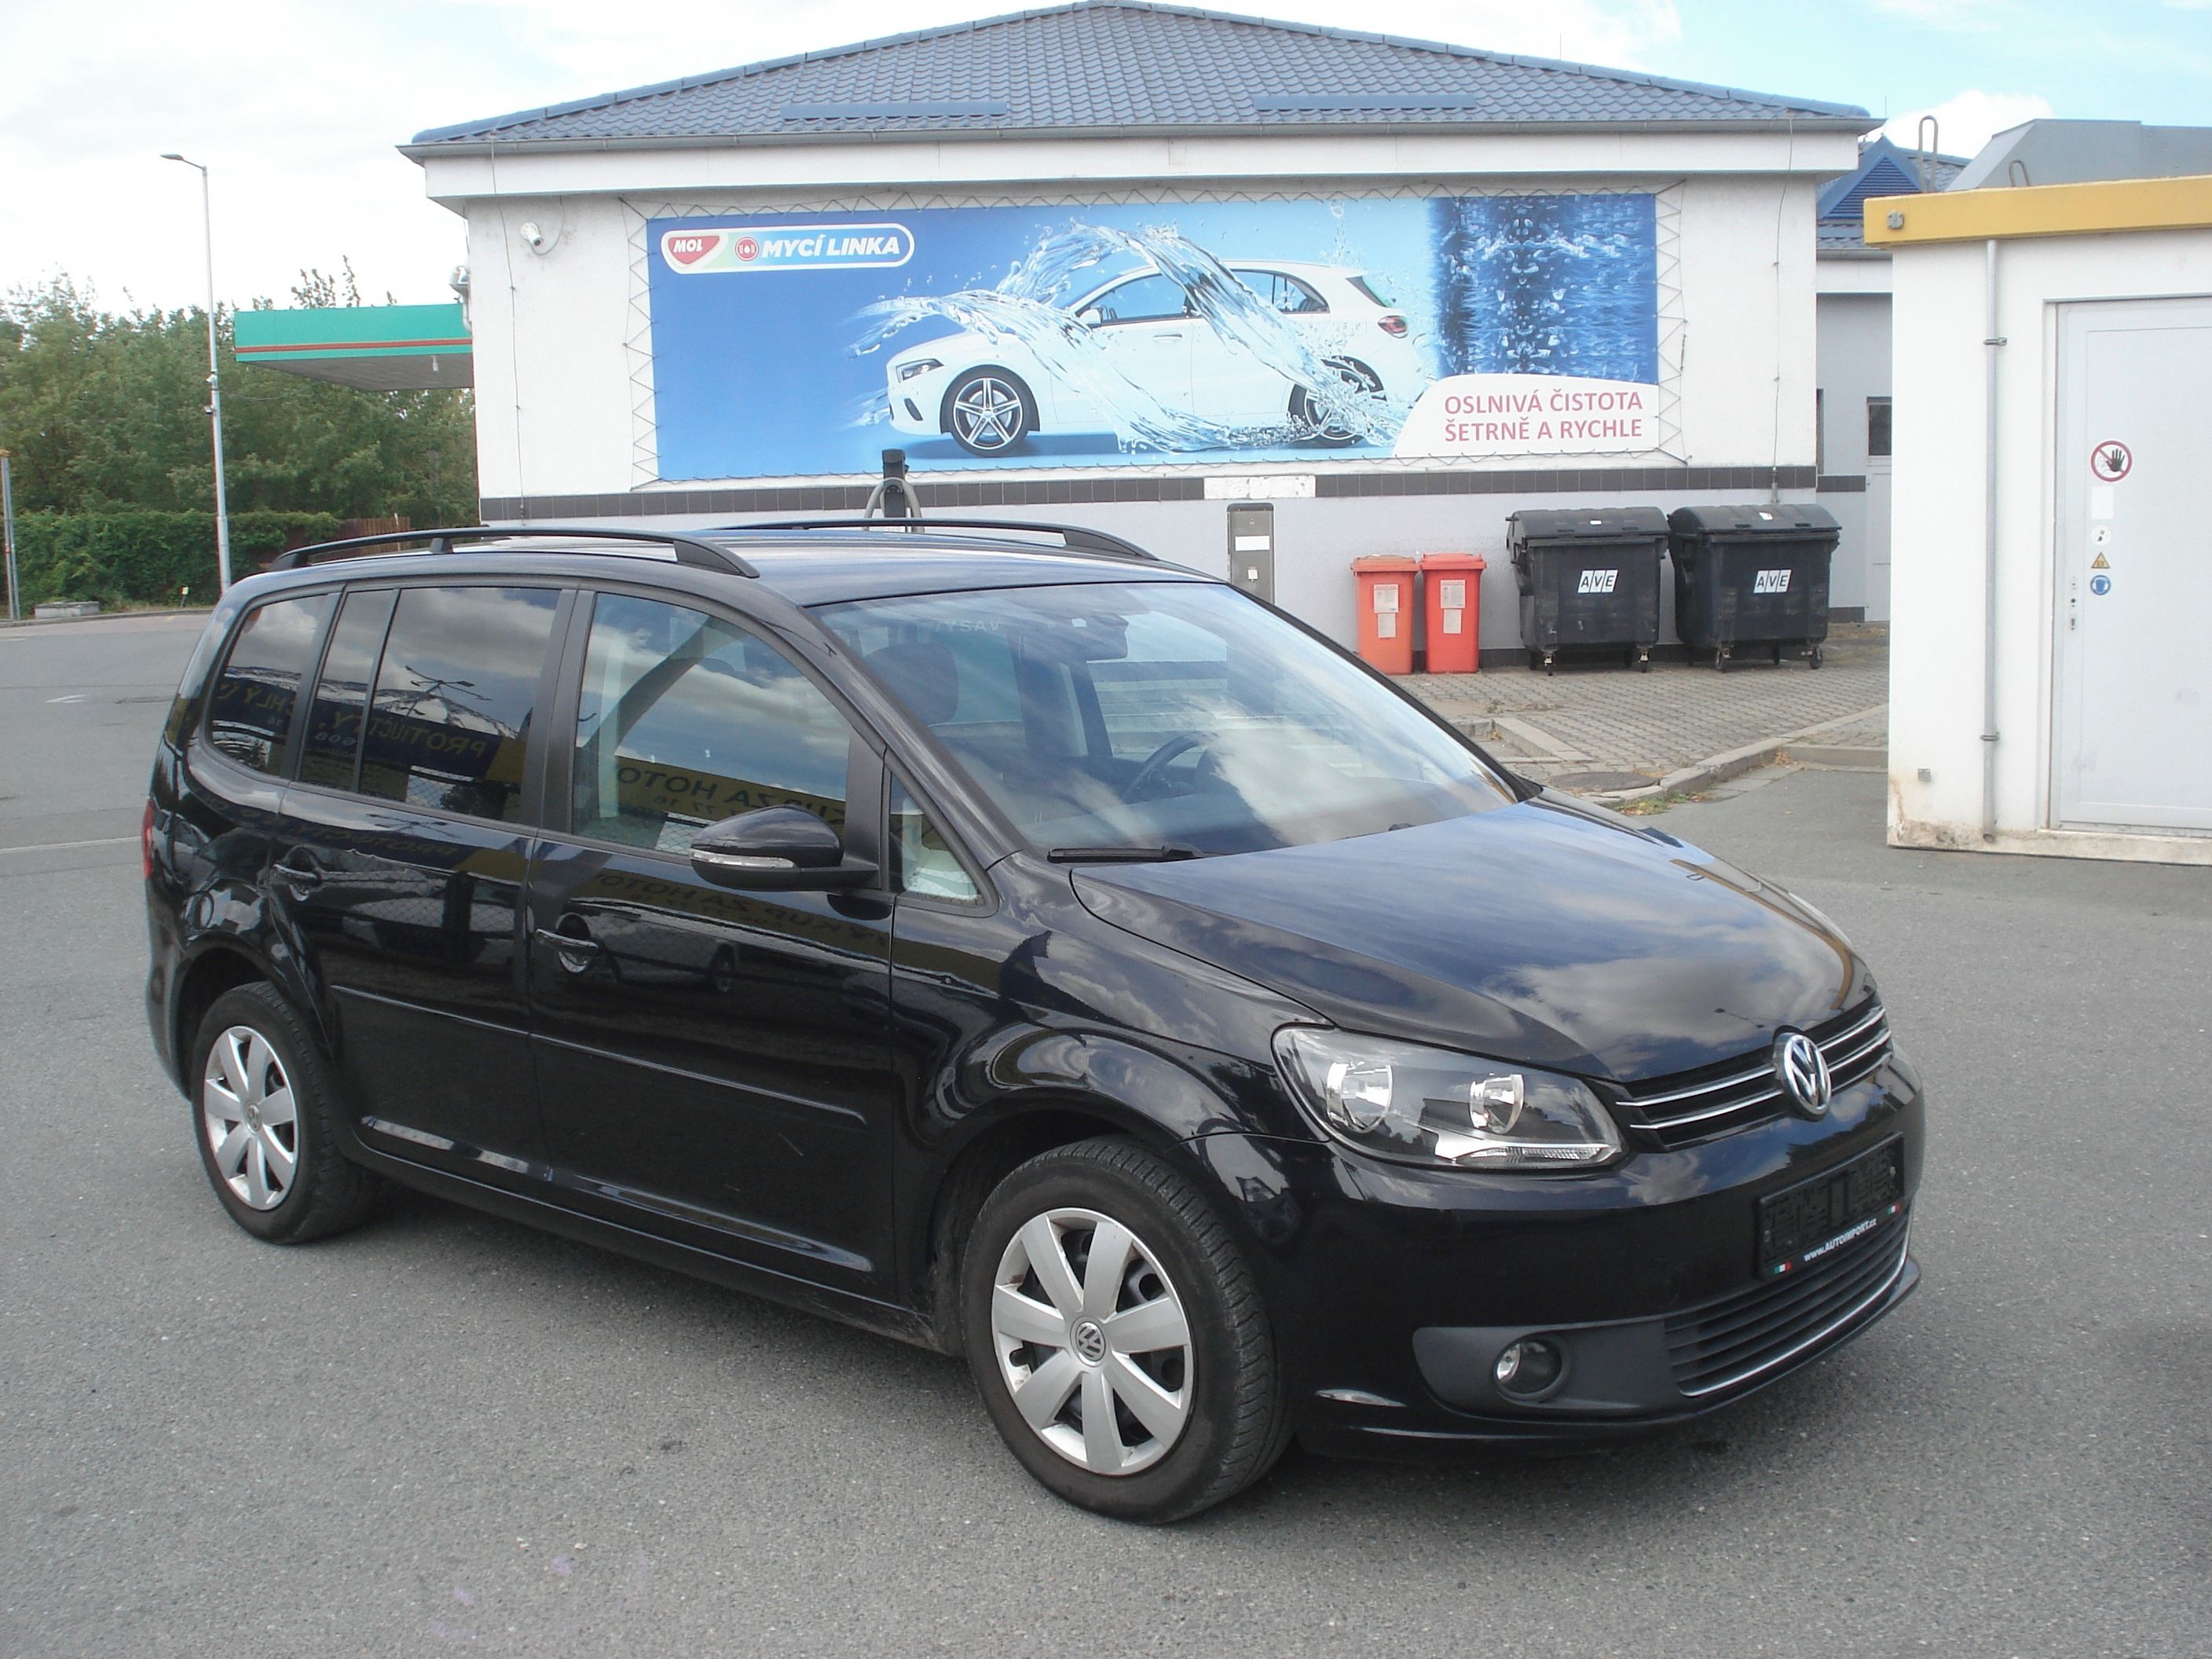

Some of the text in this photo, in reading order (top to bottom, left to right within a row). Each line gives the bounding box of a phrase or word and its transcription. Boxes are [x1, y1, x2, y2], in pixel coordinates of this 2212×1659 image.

[672, 239, 703, 254] MOL
[763, 235, 899, 258] MYCÍ LINKA
[1445, 388, 1643, 415] OSLNIVÁ ČISTOTA
[1445, 417, 1643, 442] ŠETRNĚ A RYCHLE
[1580, 575, 1615, 588] AVE
[1756, 575, 1788, 588] AVE
[1804, 1218, 1877, 1262] www.AUTOIMPORT.cz
